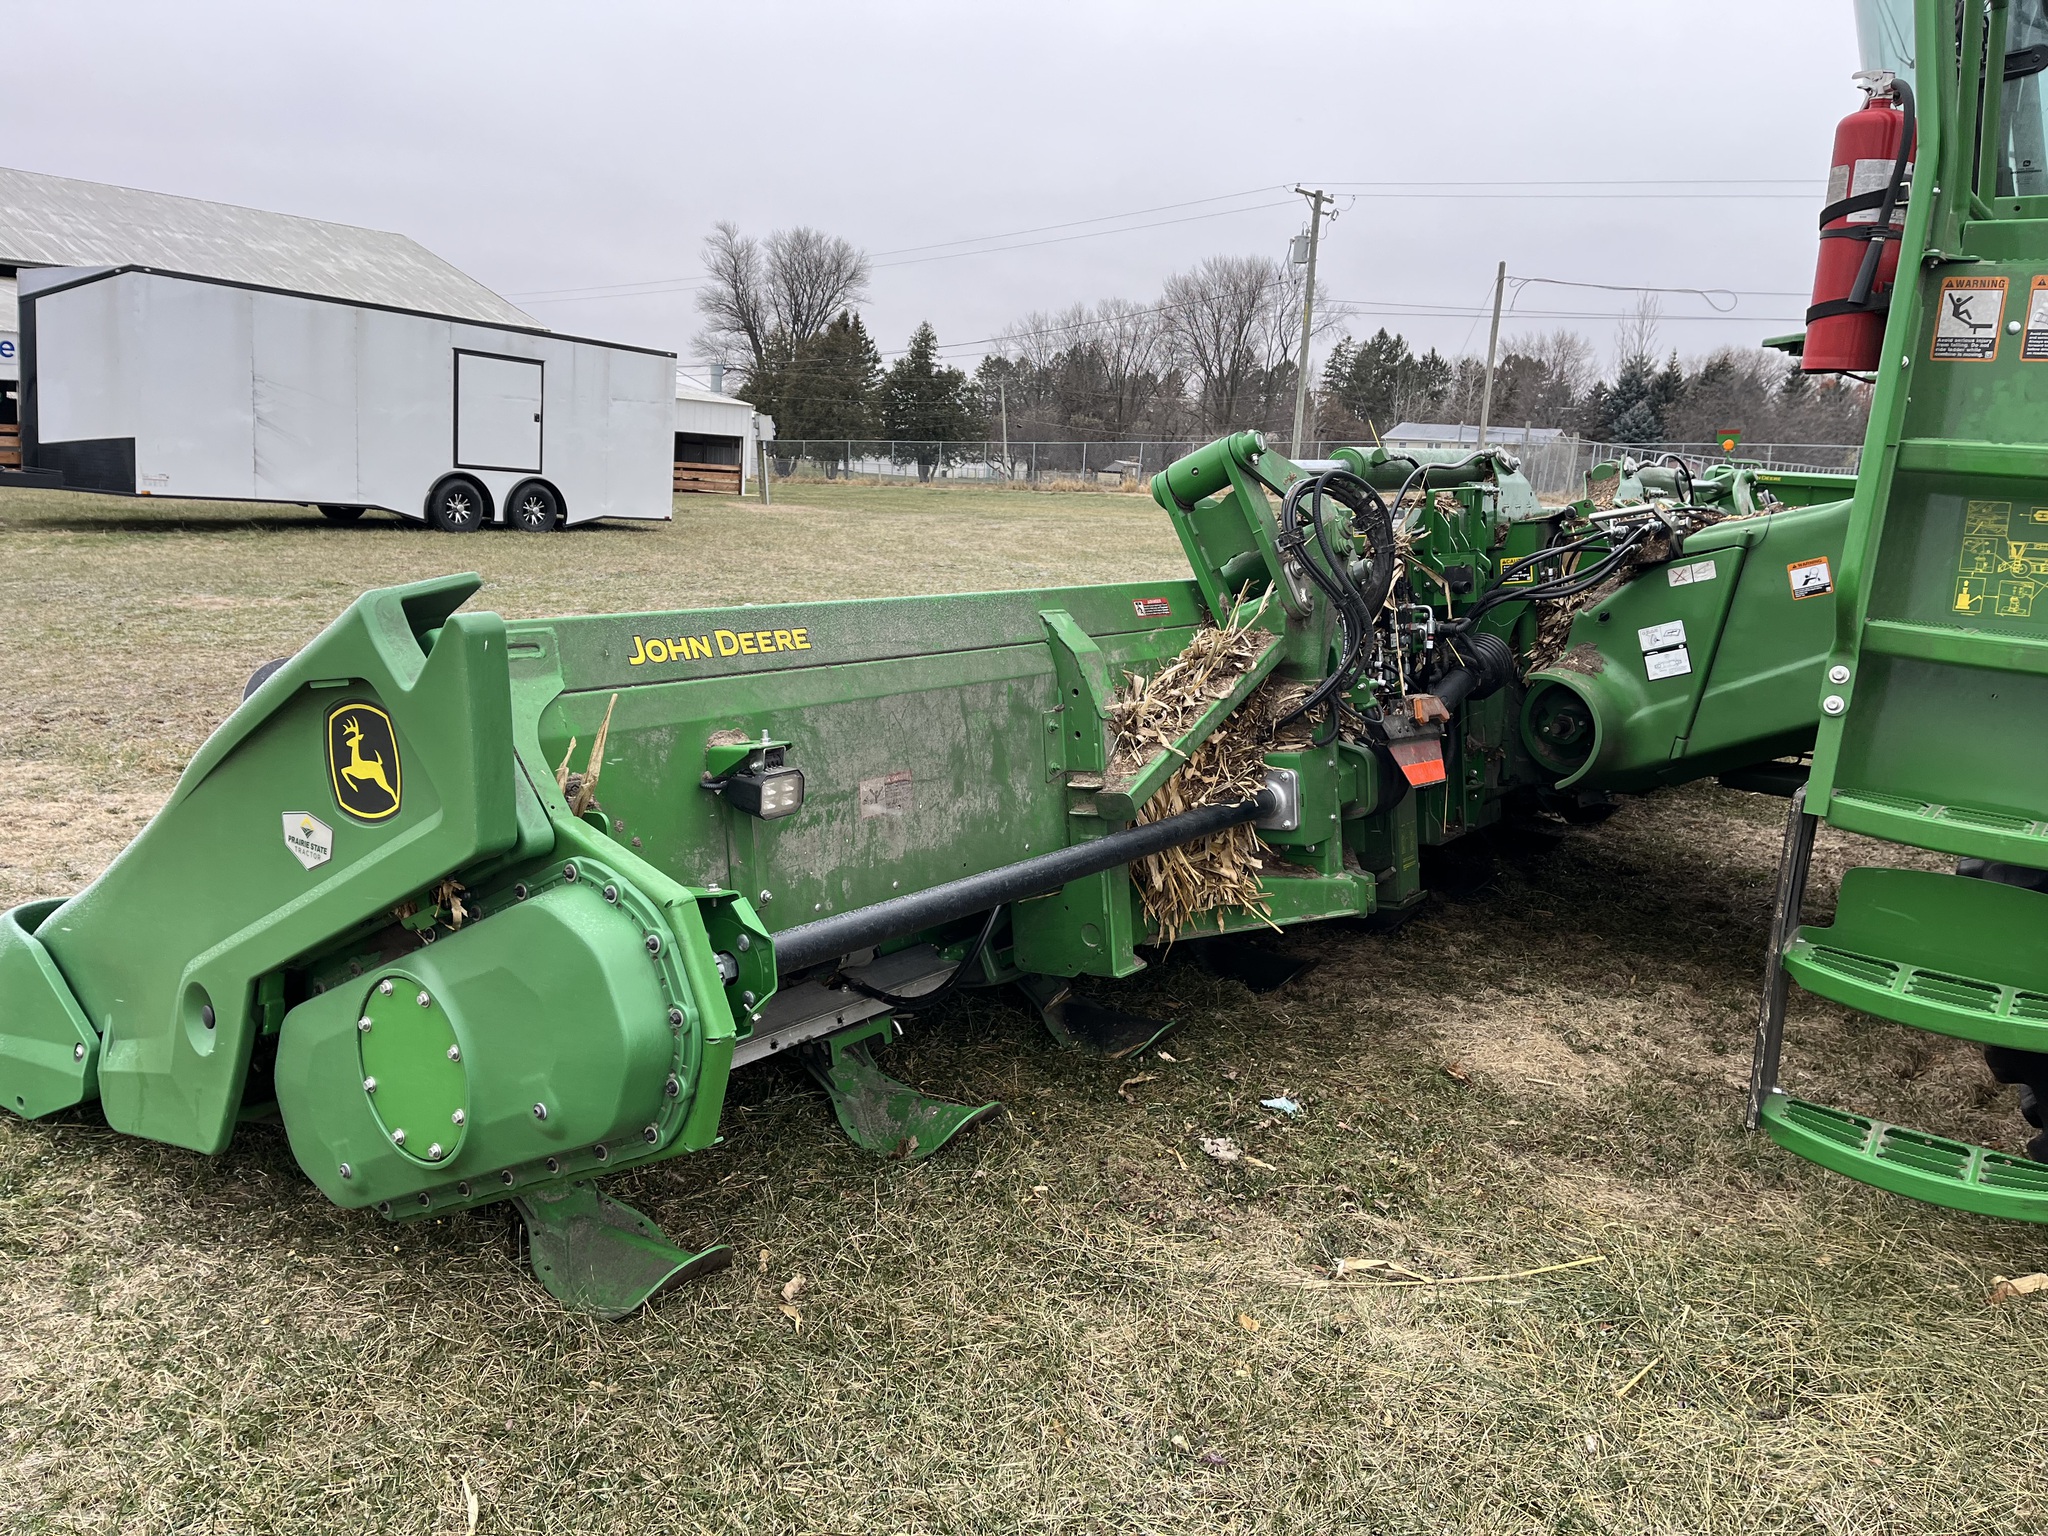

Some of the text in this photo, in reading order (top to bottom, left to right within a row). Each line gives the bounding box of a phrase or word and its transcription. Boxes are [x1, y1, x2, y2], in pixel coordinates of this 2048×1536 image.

[1956, 279, 2006, 288] WARNING
[1797, 559, 1822, 567] WARNING
[628, 627, 812, 666] JOHN DEERE
[288, 835, 328, 855] PRAIRIE STATE
[294, 846, 321, 860] TRACTOR
